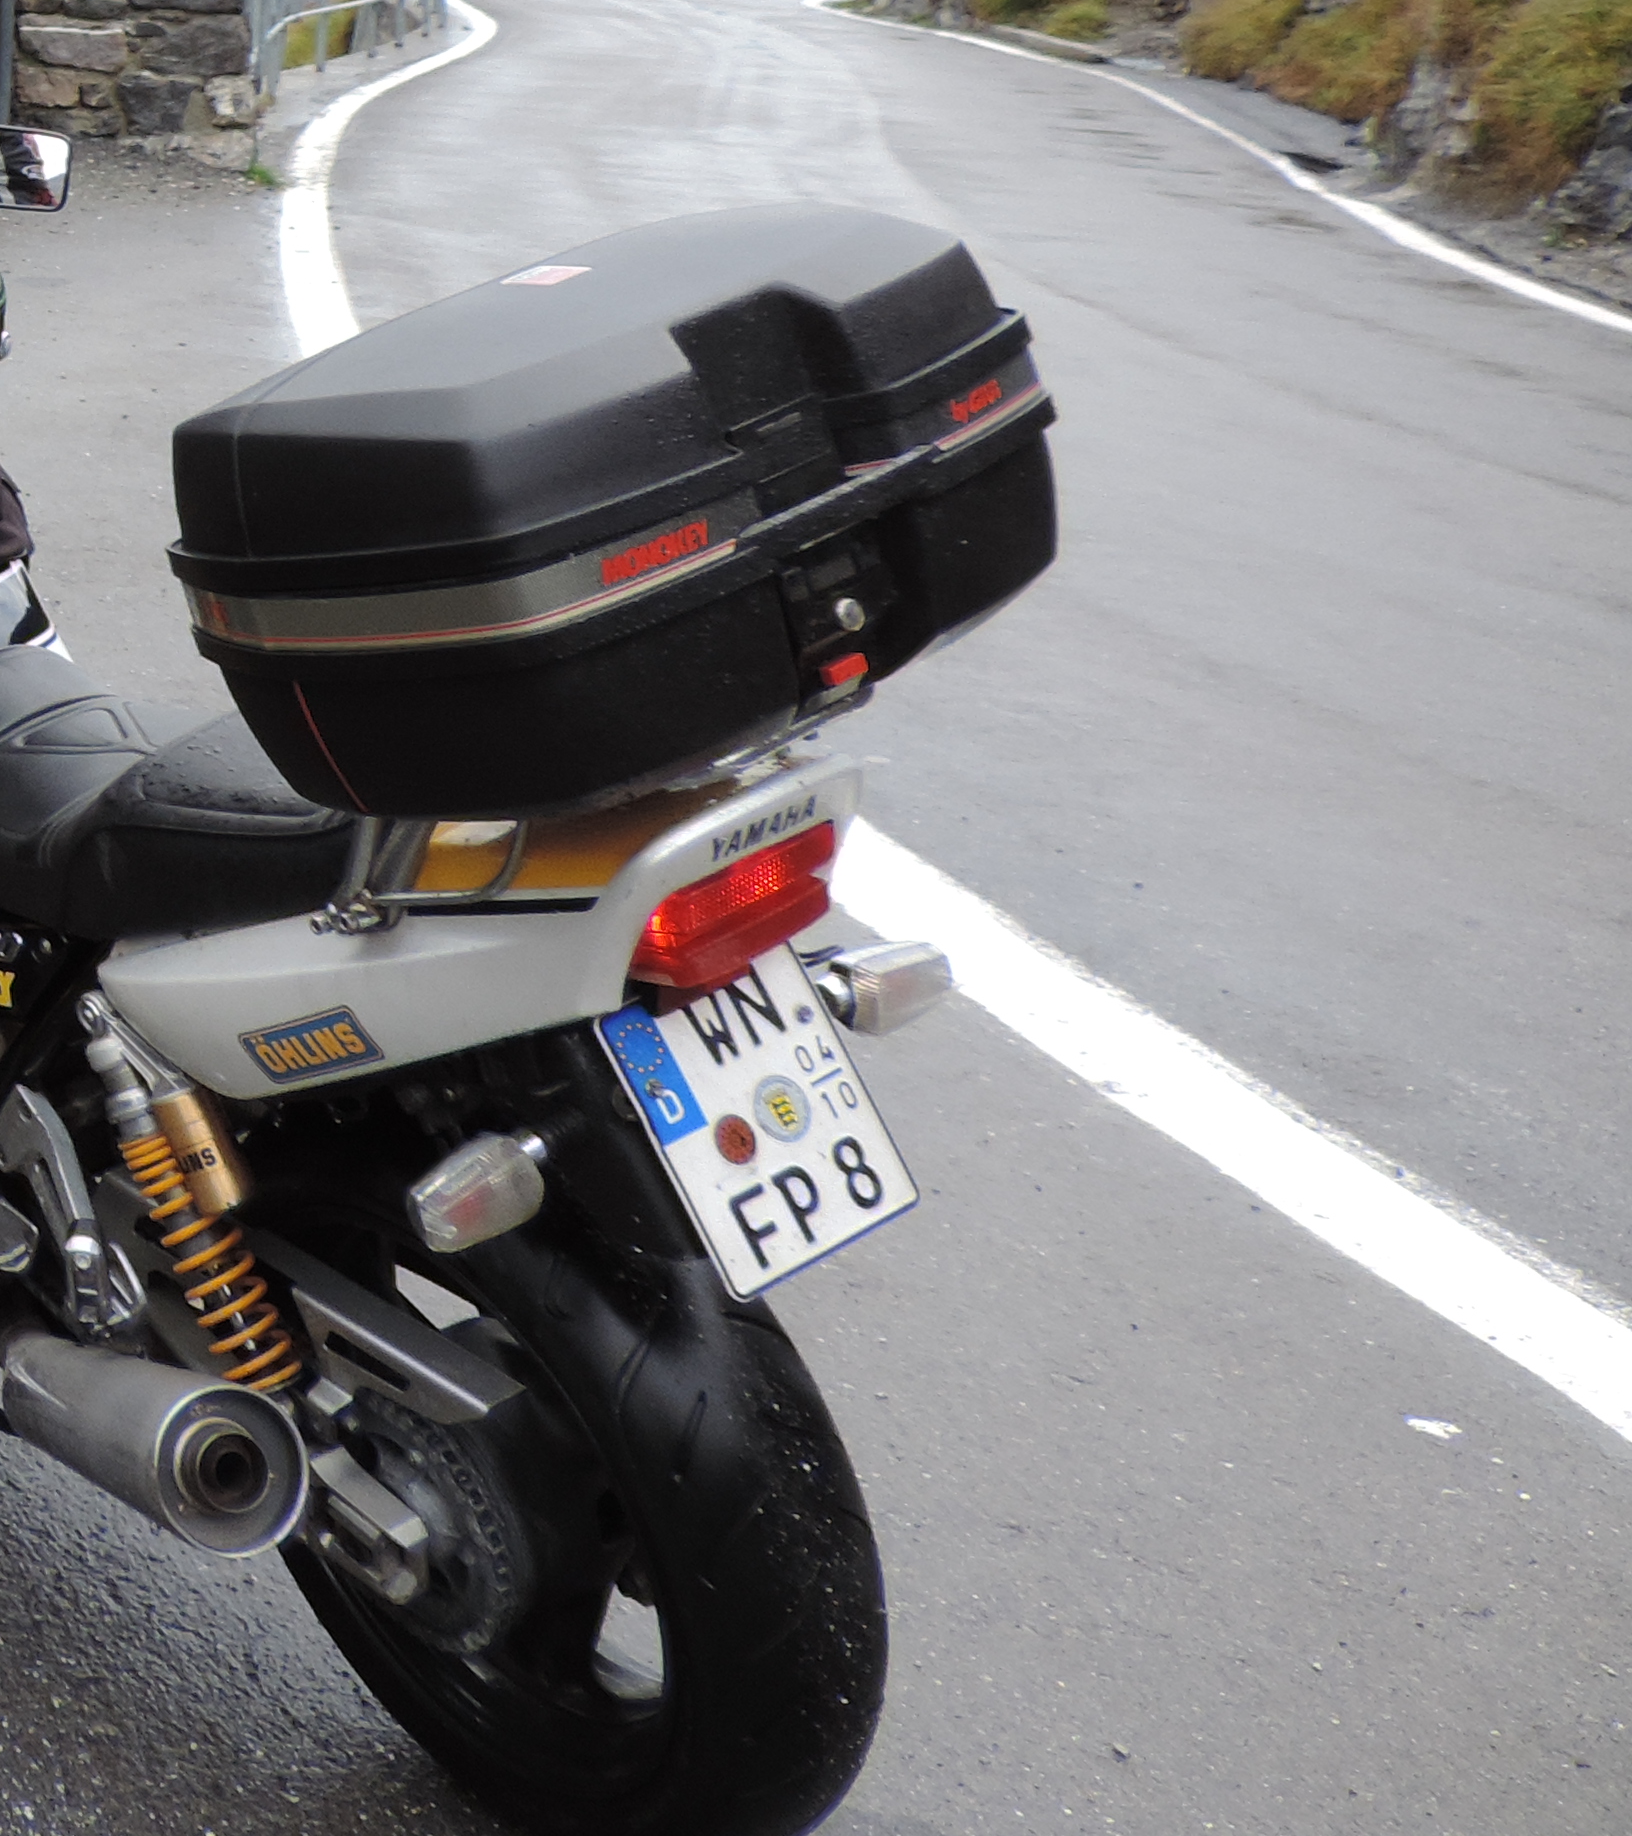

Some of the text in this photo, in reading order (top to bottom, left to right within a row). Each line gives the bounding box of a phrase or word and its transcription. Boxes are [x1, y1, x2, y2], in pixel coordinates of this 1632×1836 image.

[712, 795, 817, 862] YAMAHA
[250, 1022, 367, 1074] ÖHLINS
[653, 1086, 686, 1126] D
[820, 1081, 858, 1119] 10
[729, 1136, 884, 1271] FP 8
